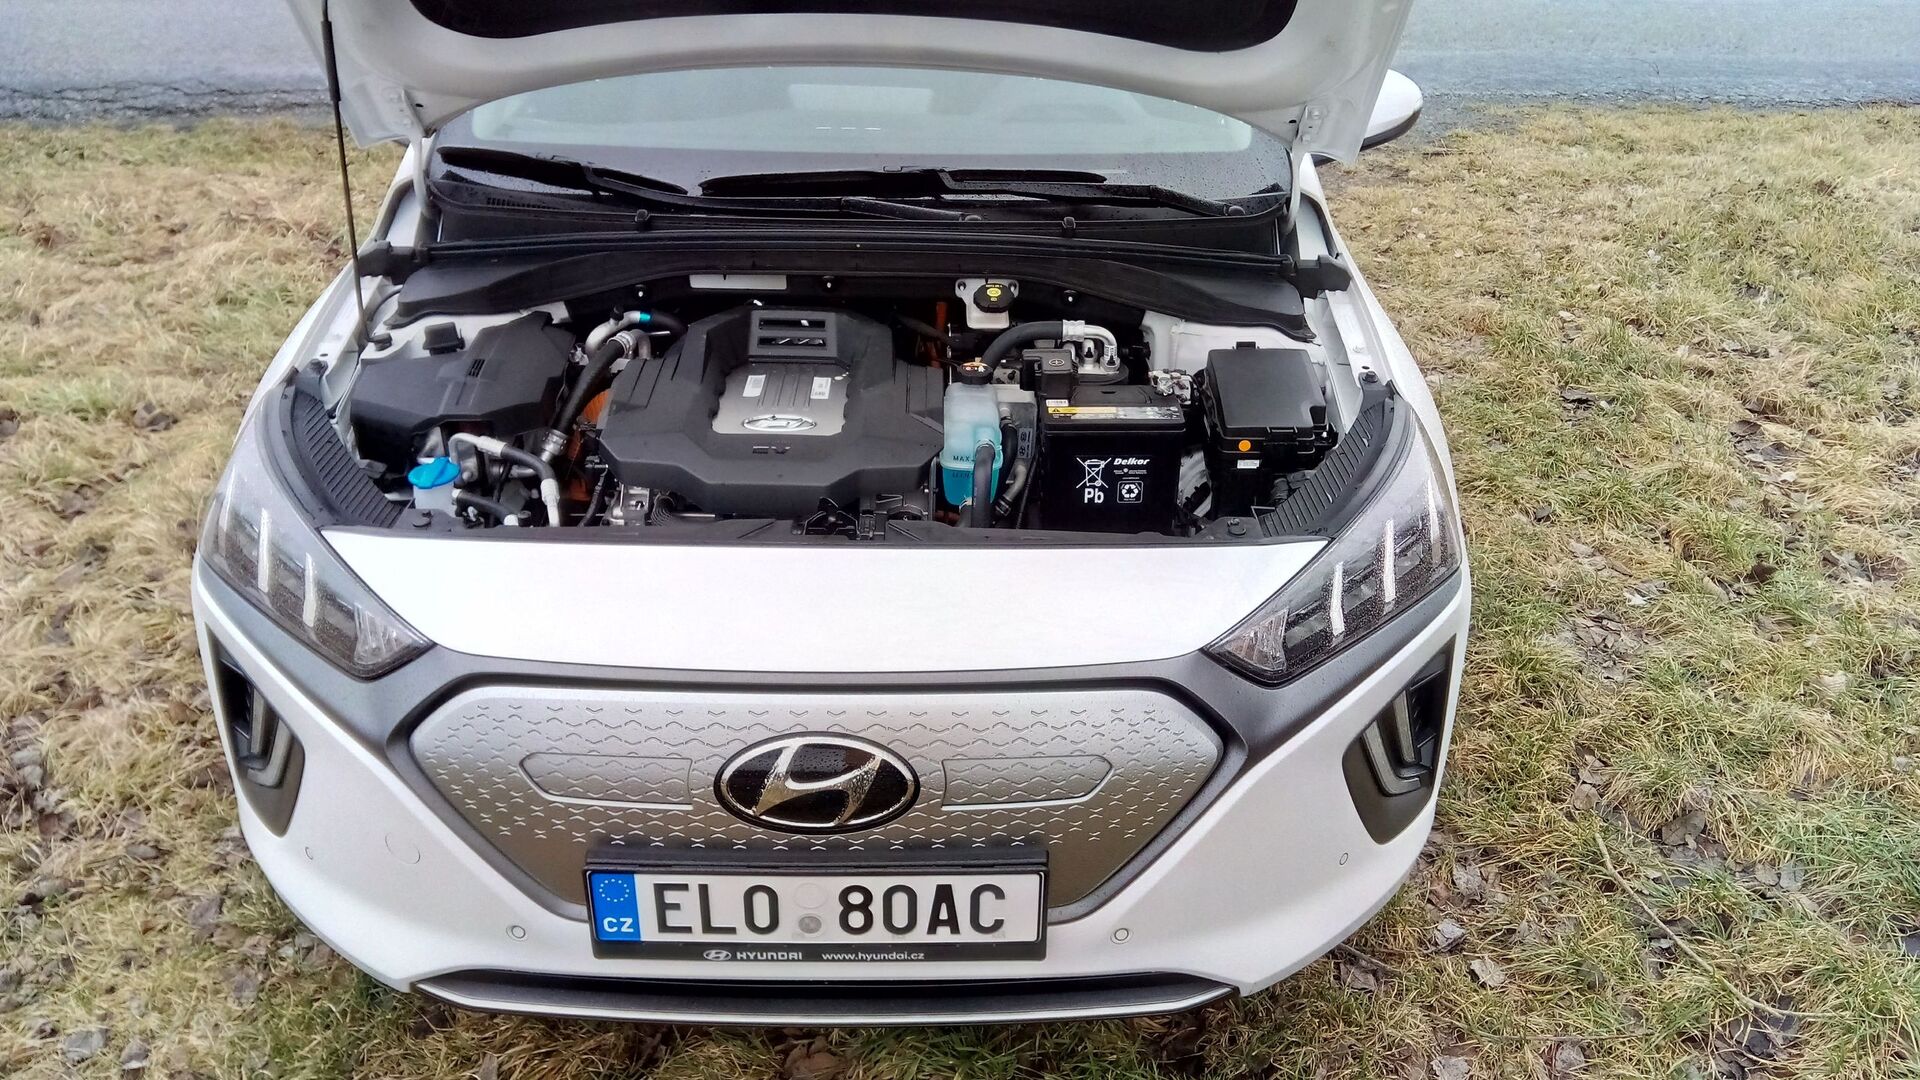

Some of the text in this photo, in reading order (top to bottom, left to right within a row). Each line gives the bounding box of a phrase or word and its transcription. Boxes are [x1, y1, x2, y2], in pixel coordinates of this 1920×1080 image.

[1113, 457, 1150, 465] Delkor
[1084, 487, 1104, 503] Pb
[838, 883, 1006, 936] 80AC
[603, 917, 634, 933] CZ
[736, 950, 925, 962] HYUNDAI www.hyundai.cz
